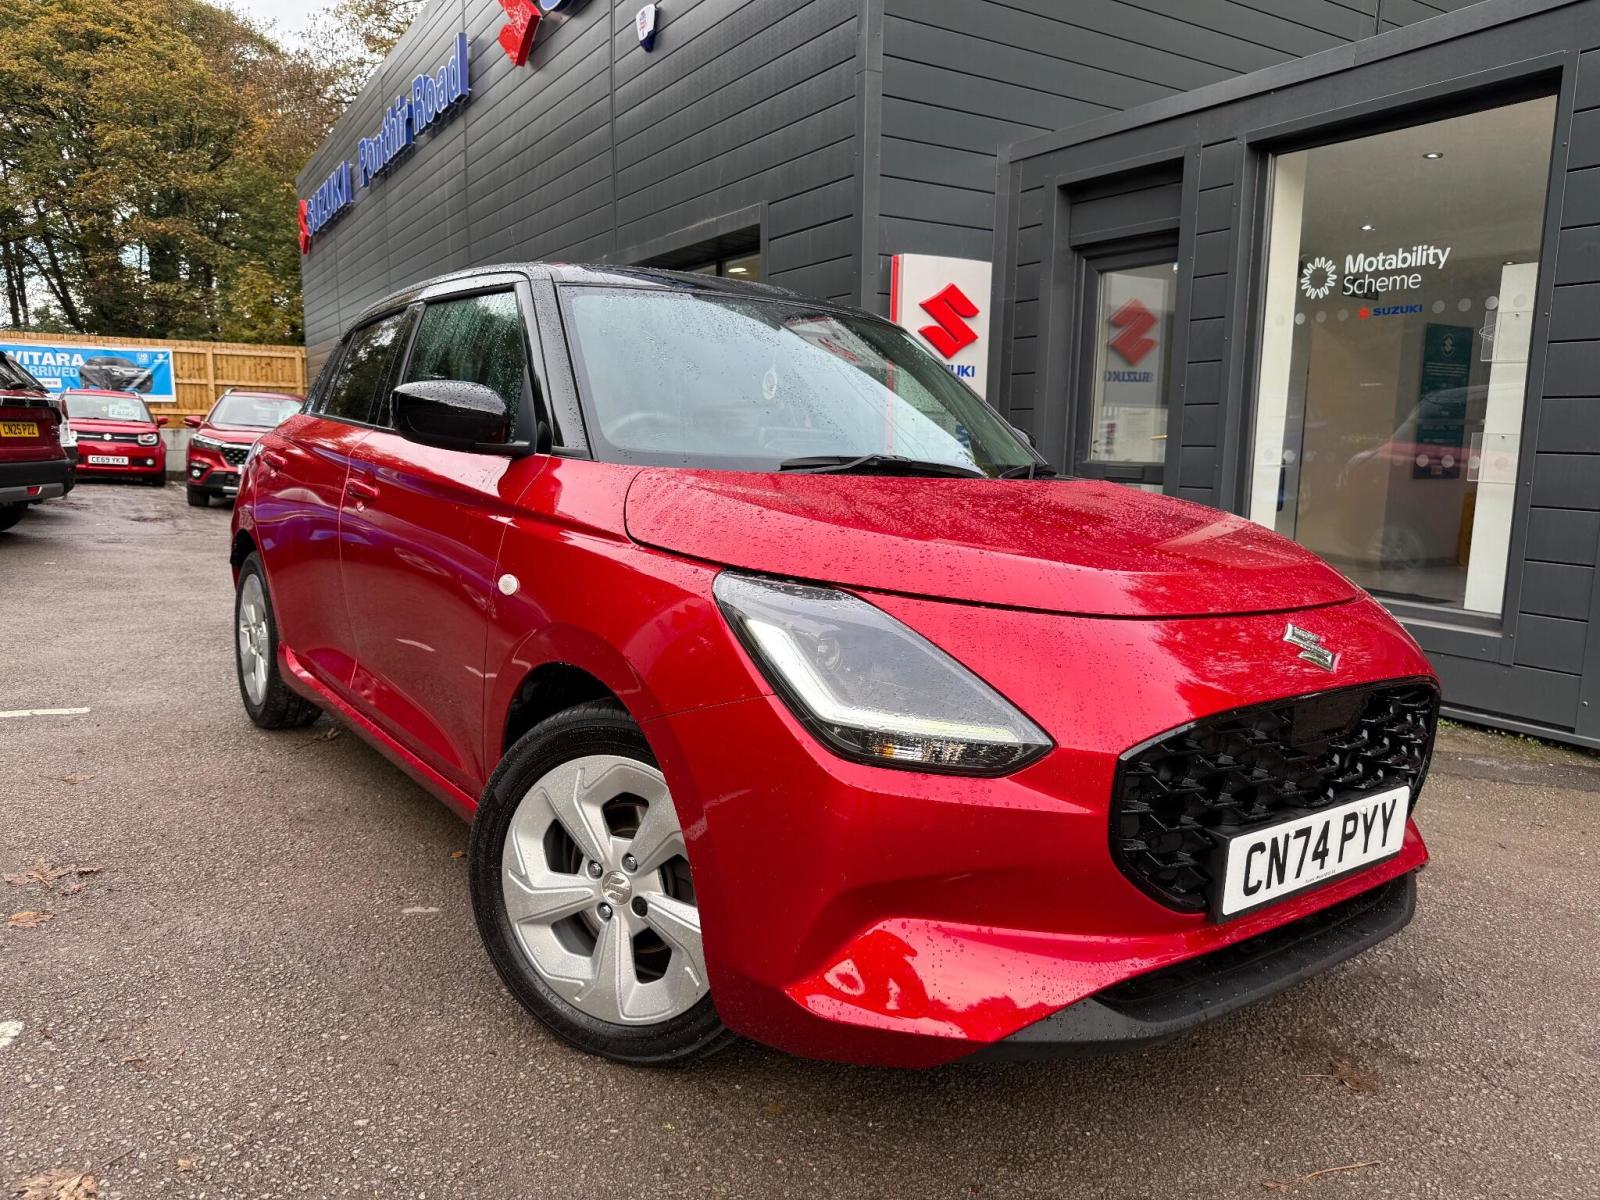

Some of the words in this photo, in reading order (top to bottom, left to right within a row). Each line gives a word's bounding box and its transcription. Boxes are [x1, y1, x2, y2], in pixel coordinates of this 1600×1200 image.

[306, 161, 350, 237] SUZUKI
[358, 95, 411, 188] Ponthir
[412, 32, 467, 136] Road
[1344, 244, 1451, 275] Motability
[1342, 272, 1422, 296] Scheme
[1373, 304, 1423, 317] SUZUKI
[946, 364, 976, 378] UKI
[3, 423, 22, 435] CN25
[22, 423, 36, 435] PZZ
[1242, 820, 1330, 897] CN74
[1337, 798, 1397, 864] PYY
